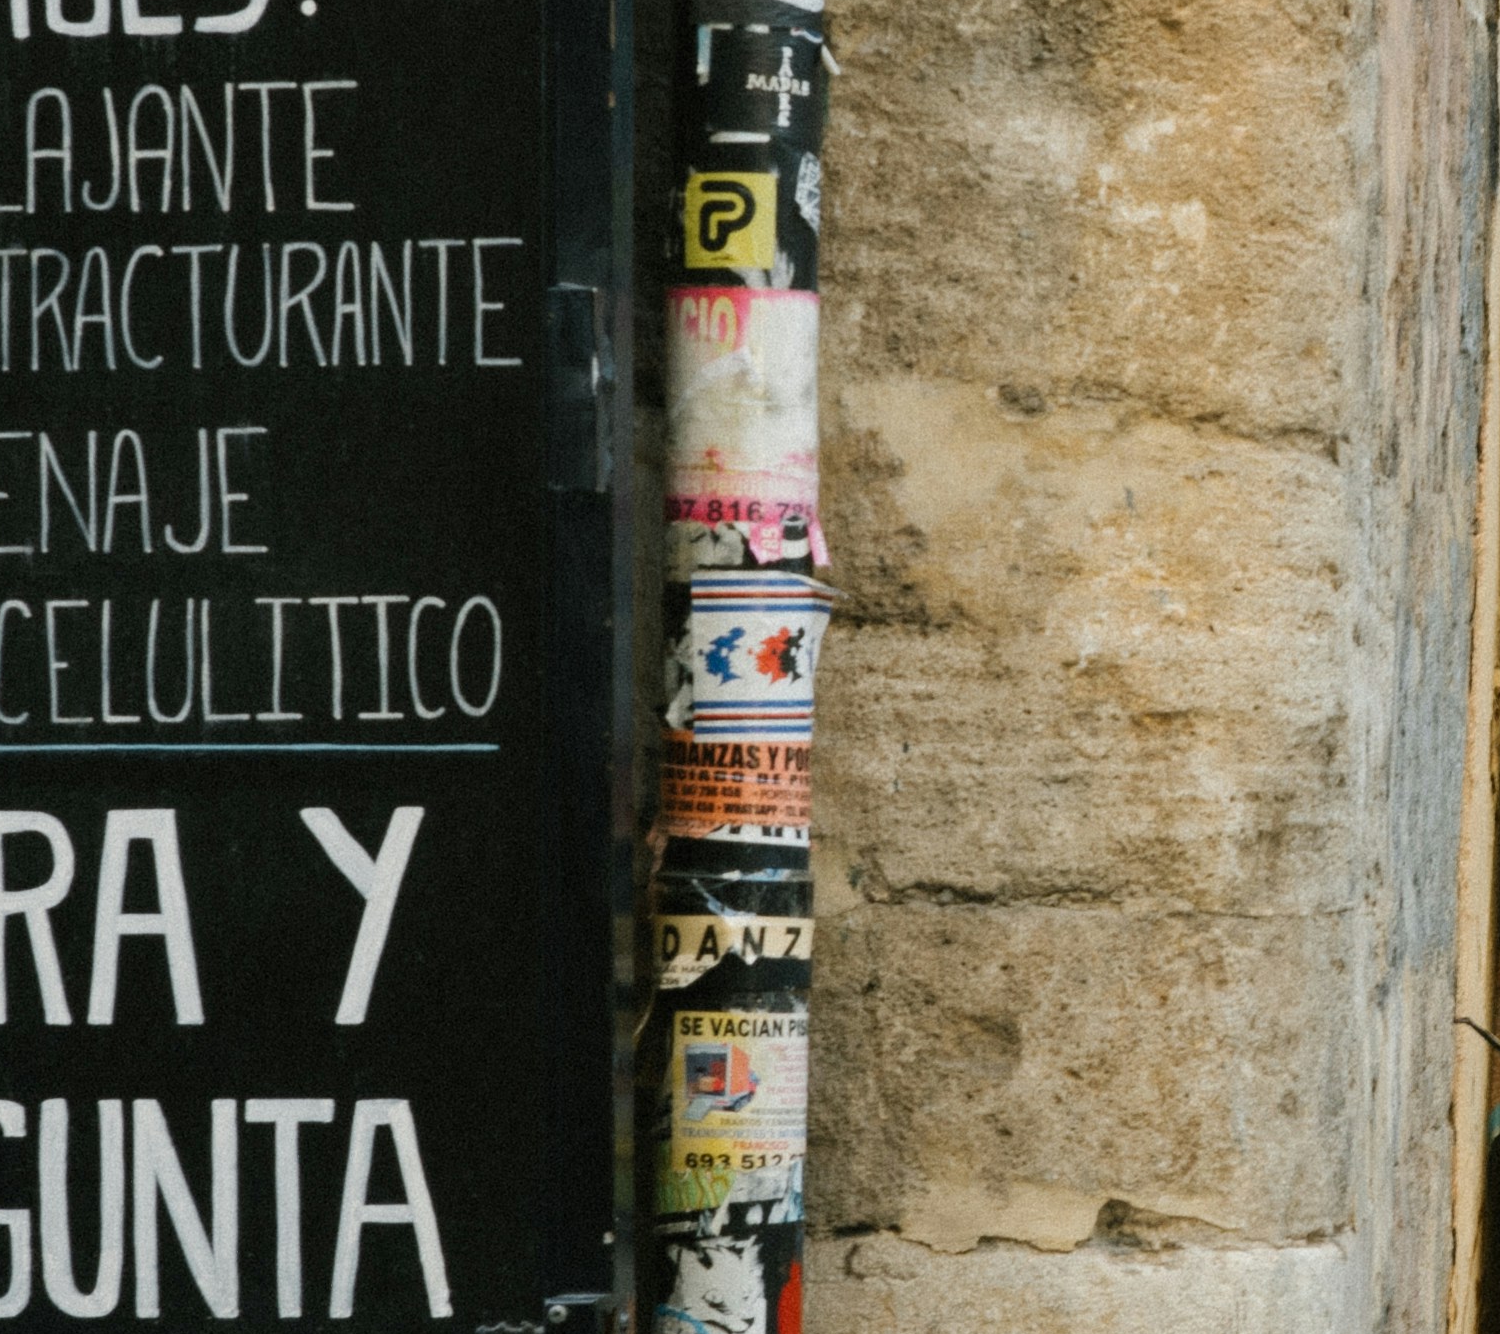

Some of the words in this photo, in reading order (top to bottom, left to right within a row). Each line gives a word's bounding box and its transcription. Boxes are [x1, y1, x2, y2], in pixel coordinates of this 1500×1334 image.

[707, 498, 762, 522] 816
[300, 806, 424, 1025] Y
[680, 1017, 703, 1036] SE
[711, 1019, 782, 1038] VACIAN
